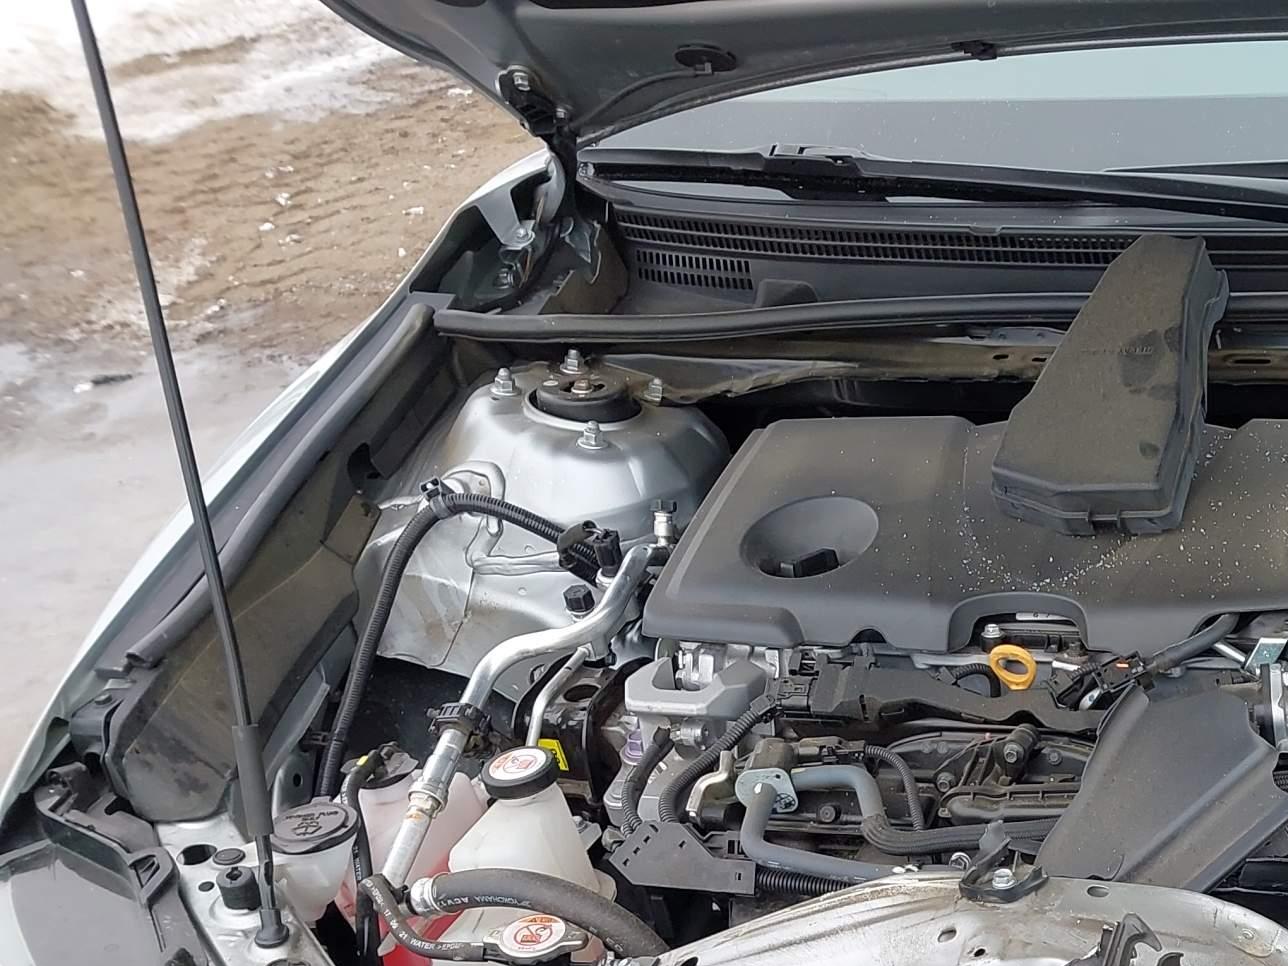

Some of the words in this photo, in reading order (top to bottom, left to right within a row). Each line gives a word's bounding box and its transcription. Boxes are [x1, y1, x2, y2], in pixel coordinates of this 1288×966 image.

[473, 894, 518, 907] YOKOHAMA
[398, 930, 409, 940] 21
[410, 937, 436, 951] WATER
